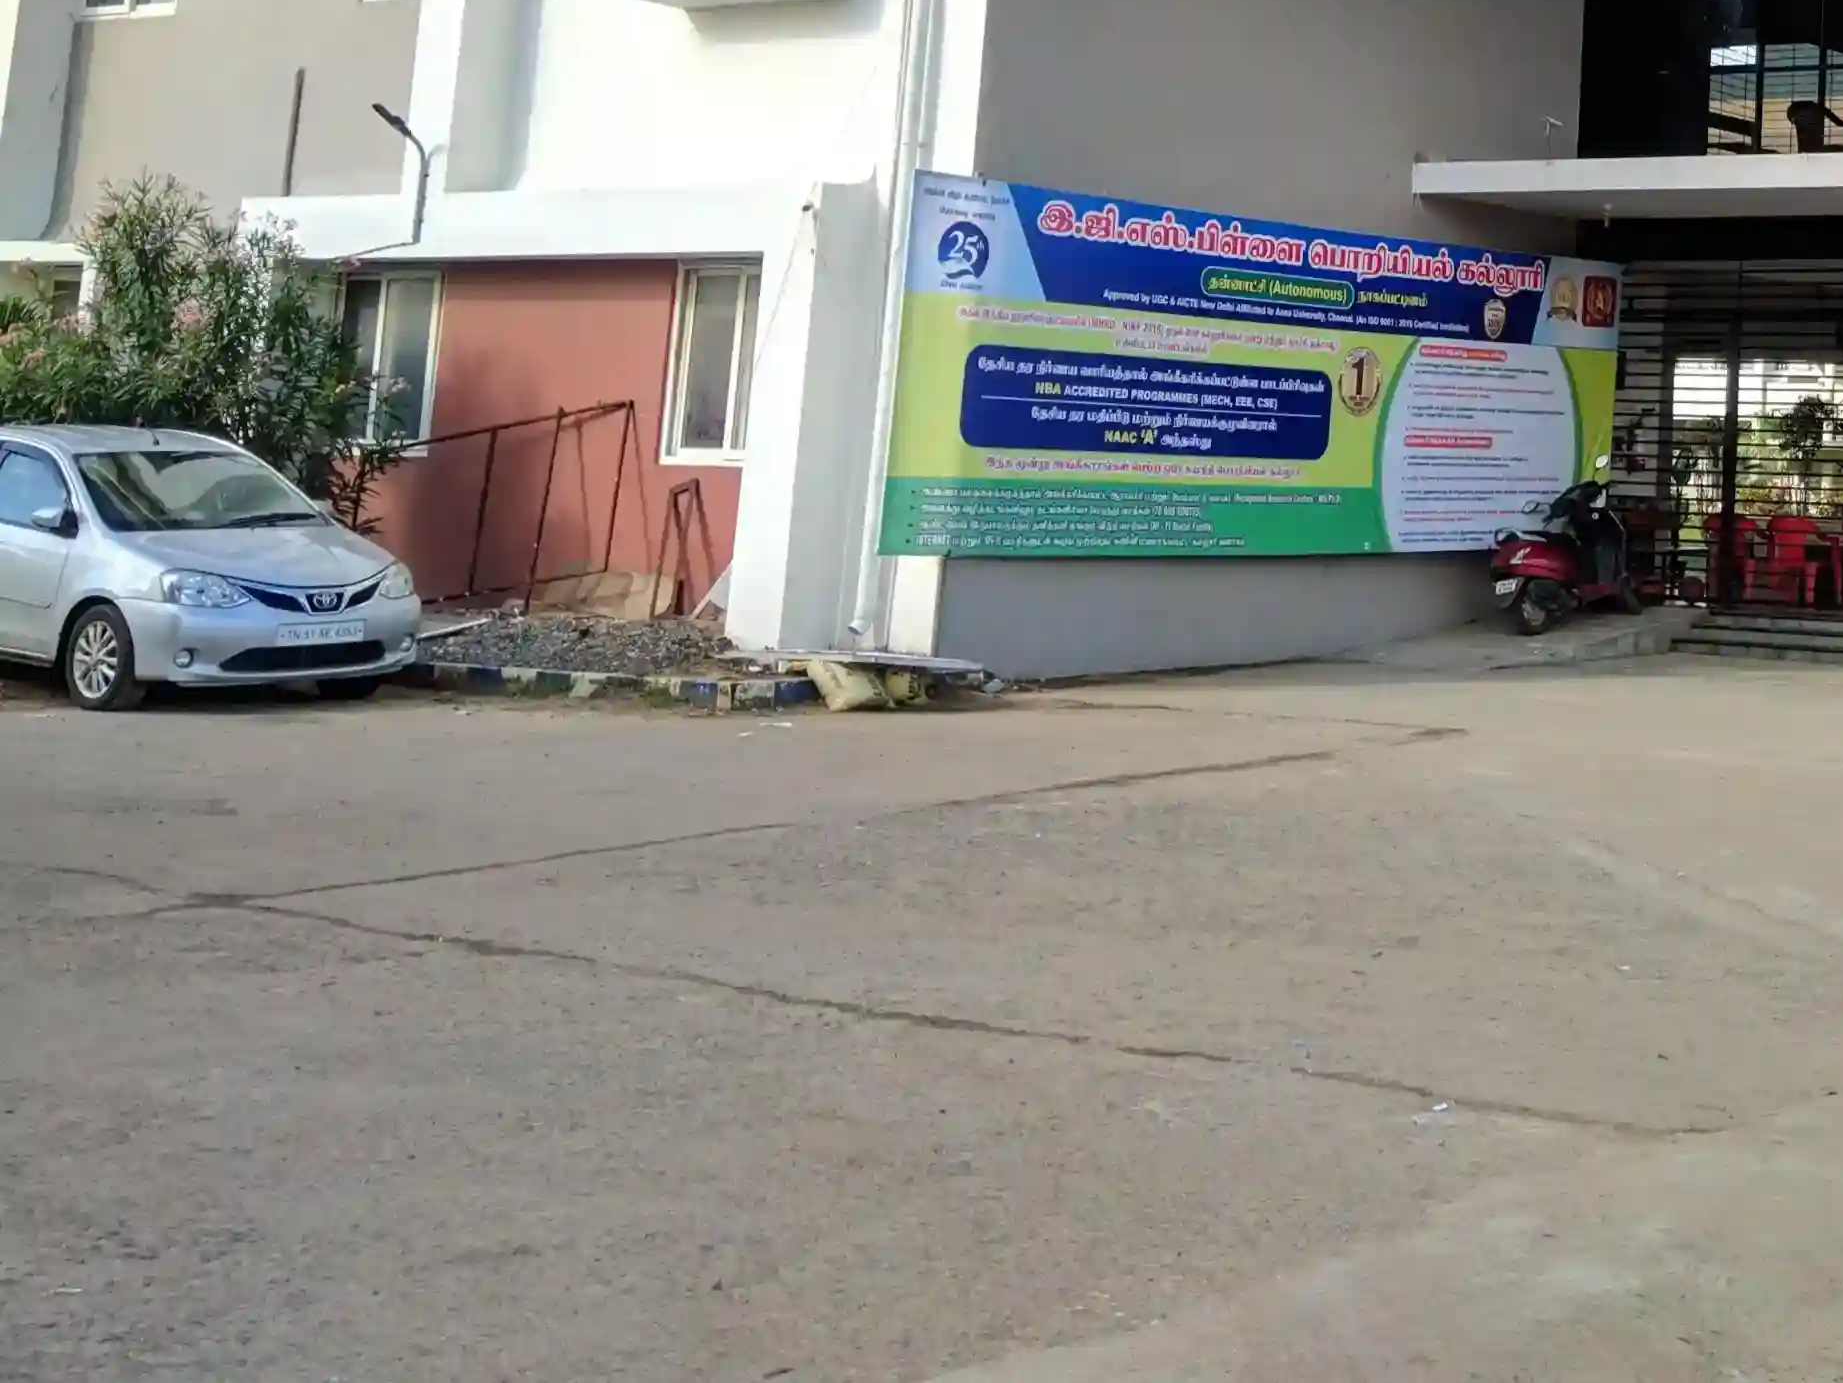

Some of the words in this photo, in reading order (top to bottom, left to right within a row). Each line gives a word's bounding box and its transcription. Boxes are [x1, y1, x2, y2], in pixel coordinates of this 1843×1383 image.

[1037, 200, 1306, 267] இ.ஜி.எஸ்.பிள்ளை
[1308, 239, 1455, 284] பொறியியல்
[1457, 252, 1546, 298] கல்லூரி
[1103, 289, 1139, 301] Approved
[1141, 293, 1150, 305] by
[1152, 294, 1168, 305] UGC
[1177, 297, 1198, 308] AICTE
[1208, 274, 1266, 294] தன்னாட்சி
[1268, 278, 1348, 305] (Autonomous)
[1035, 382, 1061, 395] NBA
[1064, 384, 1128, 399] ACCREDITED
[1131, 389, 1199, 404] PROGRAMMES
[1257, 398, 1278, 410] CSE)
[1104, 429, 1137, 444] NAAC
